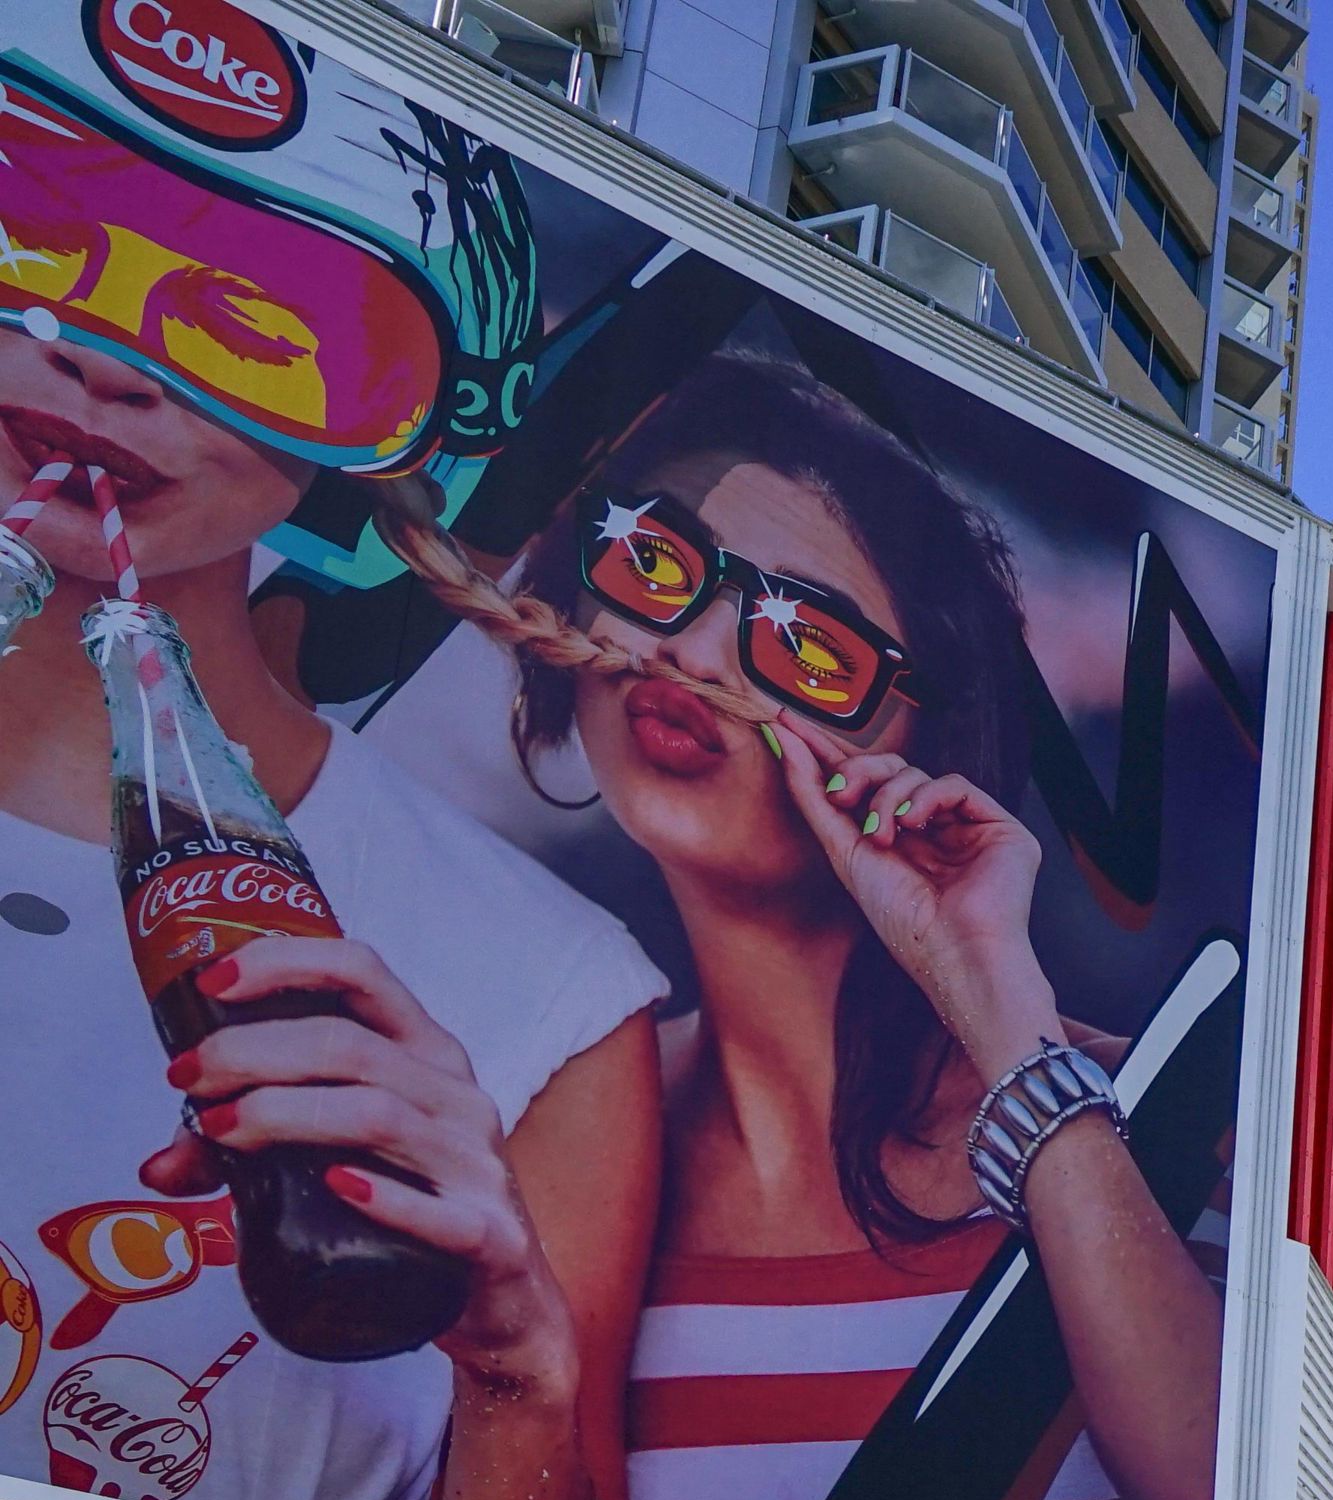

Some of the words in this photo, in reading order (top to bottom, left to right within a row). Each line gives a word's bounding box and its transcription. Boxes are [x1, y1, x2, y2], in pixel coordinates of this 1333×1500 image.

[113, 0, 280, 110] Coke
[135, 851, 172, 883] NO
[138, 862, 326, 937] Coca-Cola
